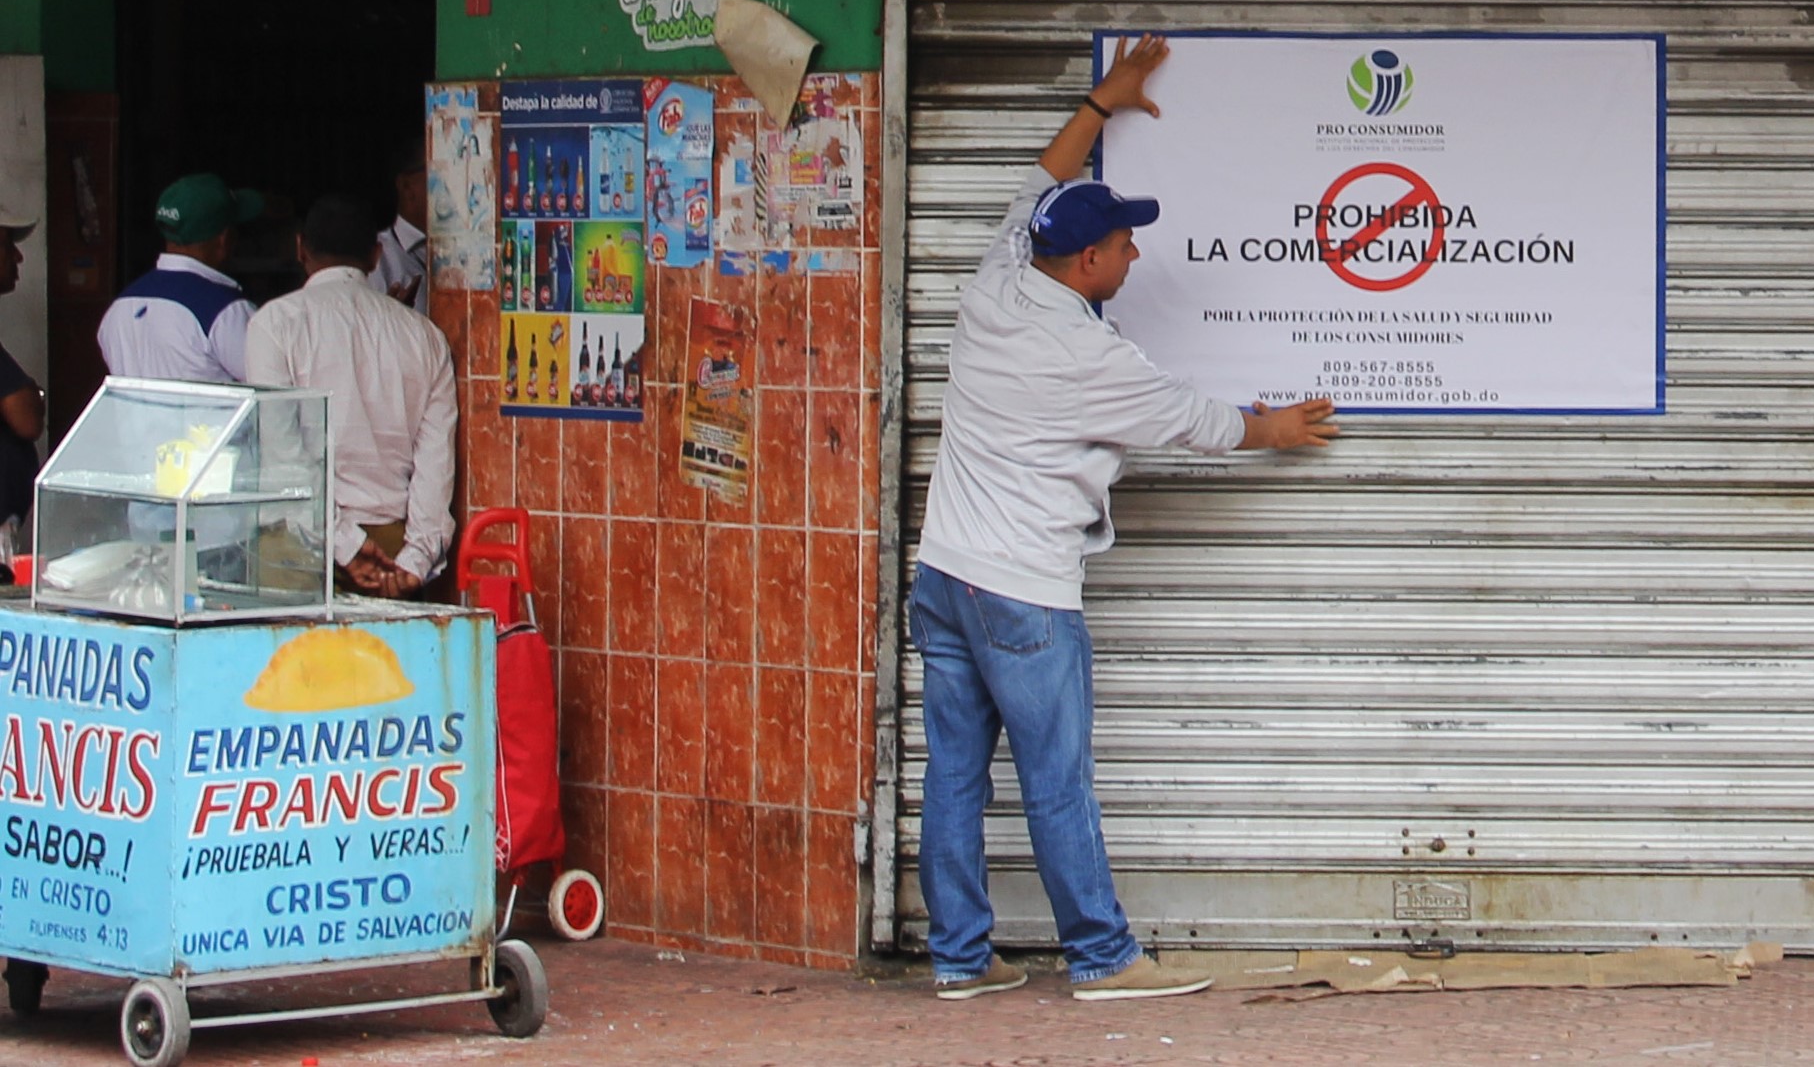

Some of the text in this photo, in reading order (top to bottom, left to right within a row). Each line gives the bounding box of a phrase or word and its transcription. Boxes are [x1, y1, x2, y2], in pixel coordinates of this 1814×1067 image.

[649, 4, 714, 43] nosotro
[502, 95, 539, 113] Destapa
[541, 94, 549, 111] la
[550, 93, 584, 111] calidad
[585, 93, 598, 110] de
[1316, 124, 1445, 136] PRO CONSUMIDOR
[1294, 204, 1476, 229] PROHIBIDA
[1187, 233, 1574, 264] LA COMERCIALIZACIÓN
[1203, 308, 1552, 324] POR LA PROTECCIÓN DE LA SALUD Y SEGURIDAD
[1292, 331, 1464, 344] DE LOS CONSUMIDORES
[1314, 375, 1443, 387] 1-809-200-8555
[1323, 360, 1435, 373] 809-567-8555
[1258, 389, 1499, 404] www.proconsumidor.gob.do
[0, 630, 155, 712] PANADAS
[187, 712, 465, 775] EMPANADAS
[0, 716, 159, 819] ANCIS
[191, 764, 465, 837] FRANCIS
[182, 839, 312, 879] ¡PRUEBALA
[335, 835, 351, 863] Y
[11, 877, 111, 917] EN CRISTO
[266, 873, 412, 915] CRISTO
[30, 919, 129, 951] FILIPENSES 4:13
[182, 929, 249, 955] UNICA
[263, 926, 305, 950] VIA
[318, 921, 346, 945] DE
